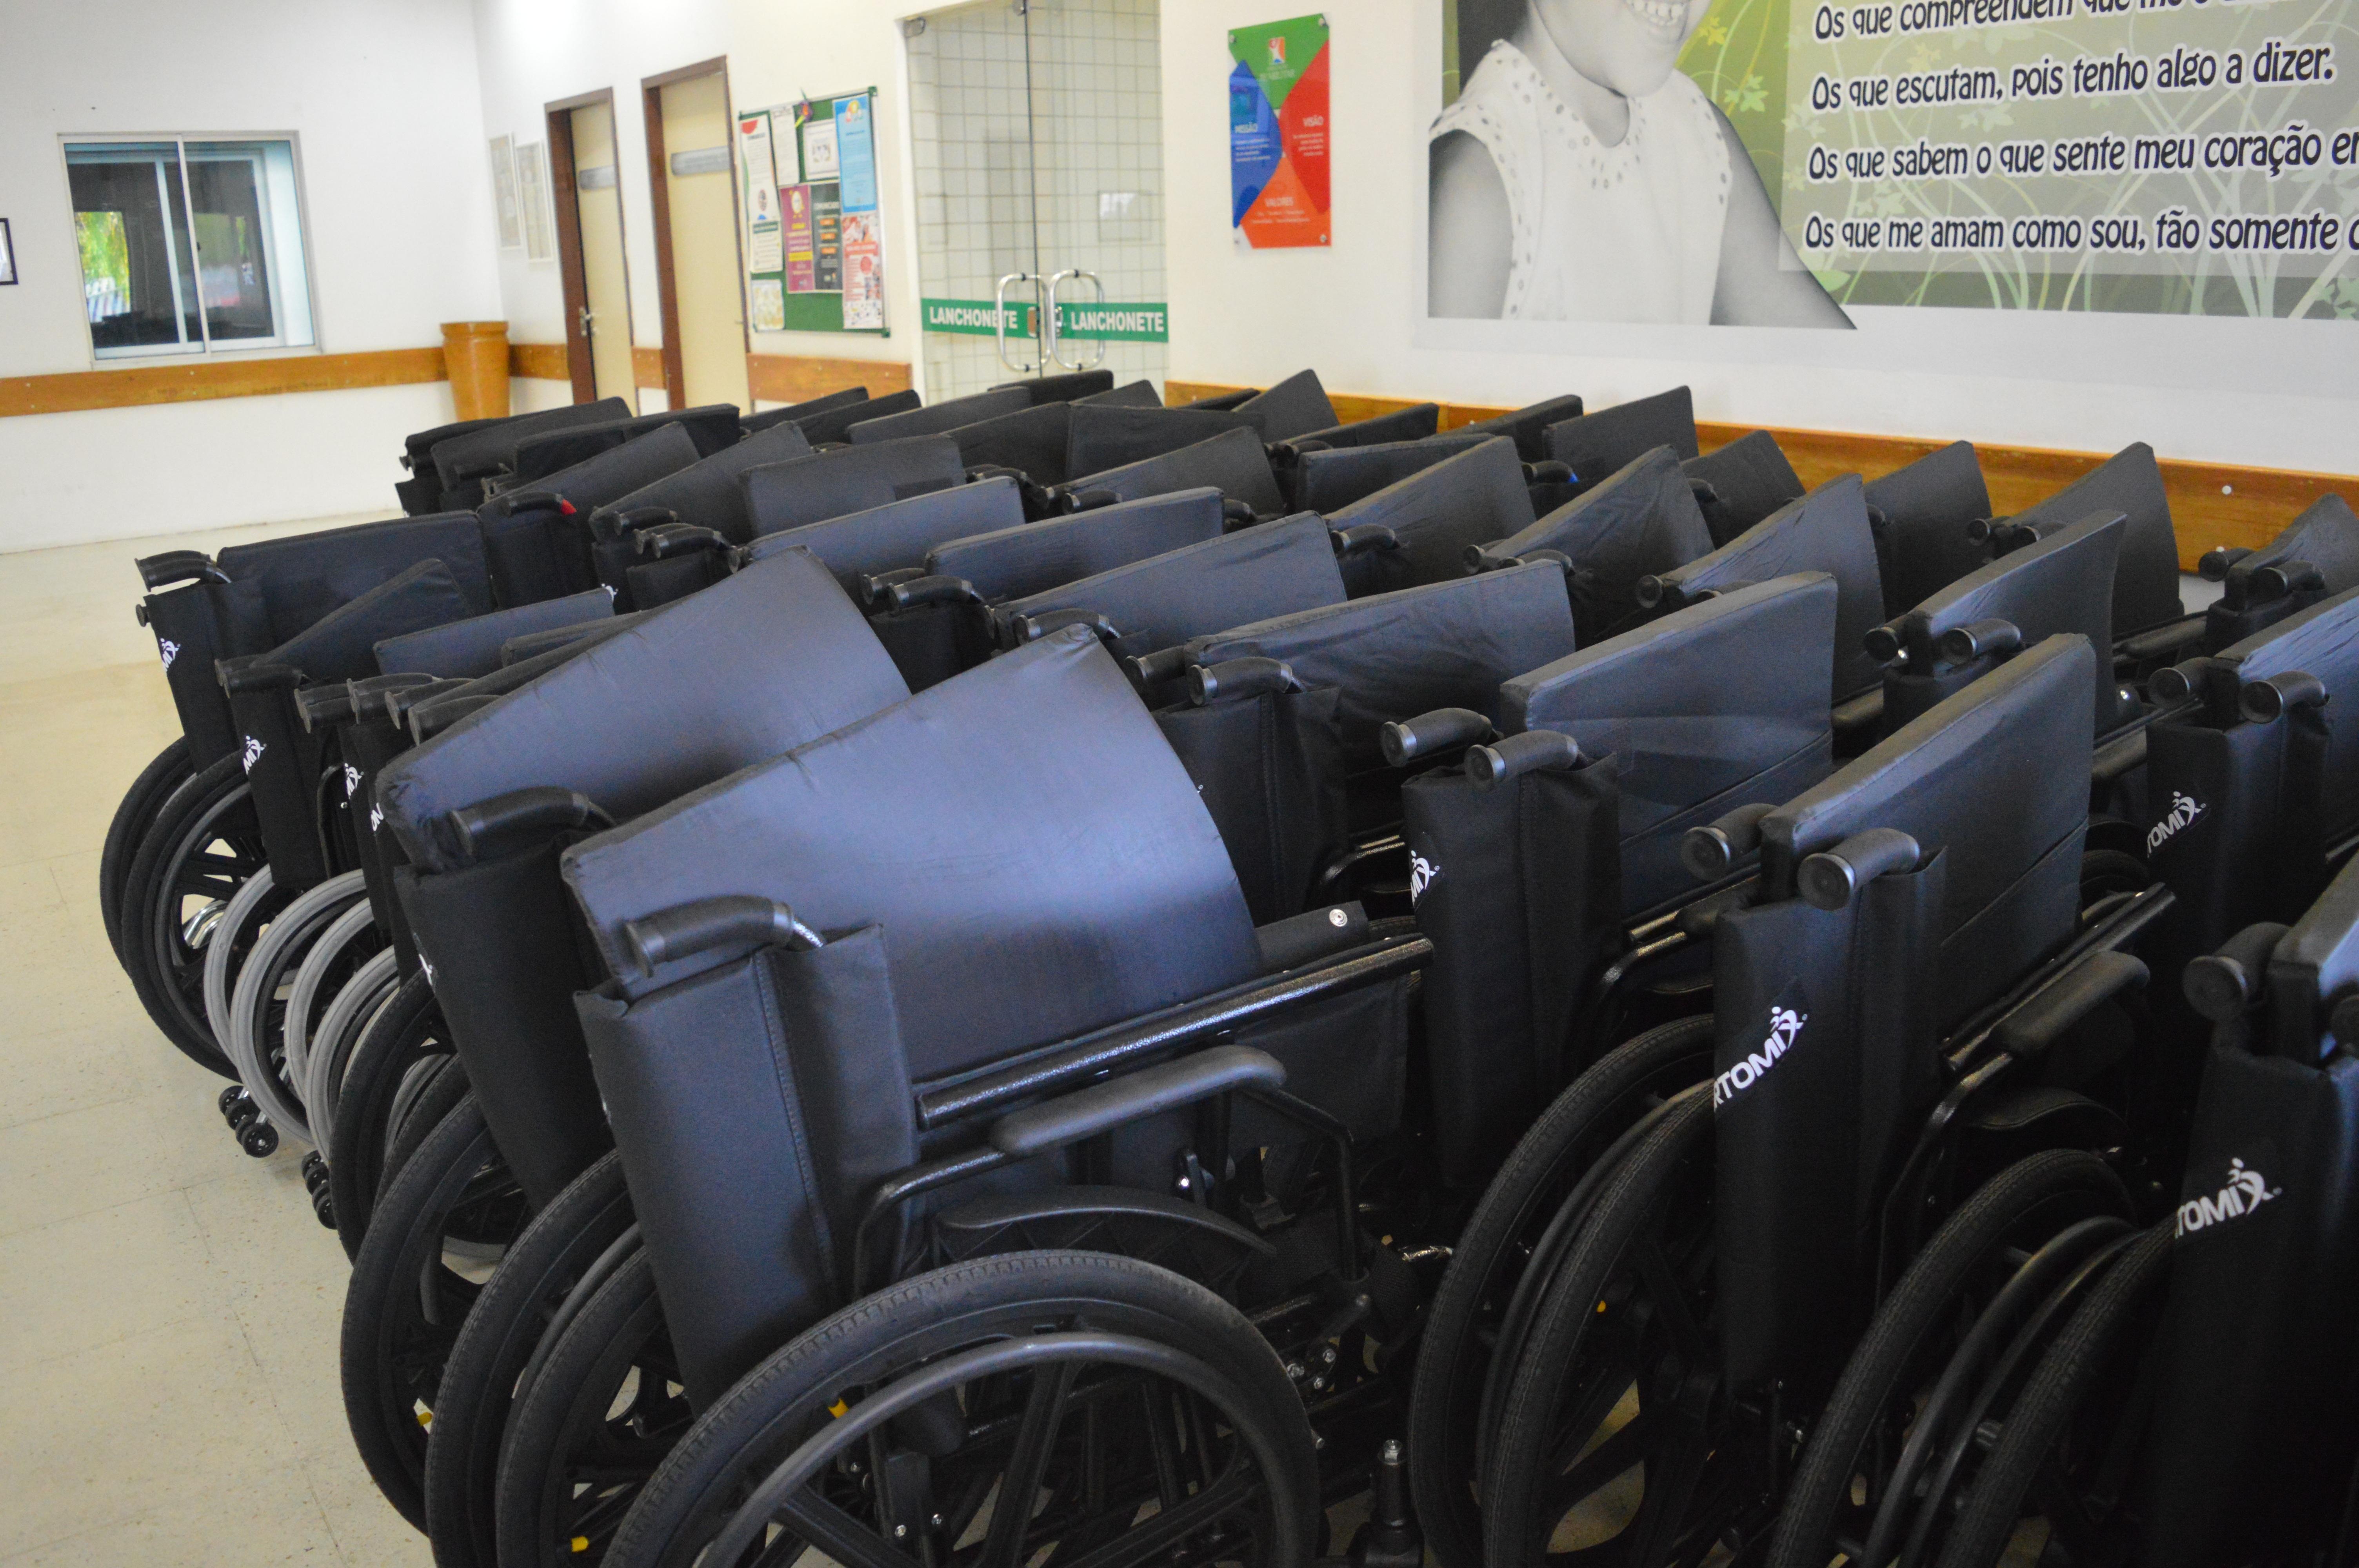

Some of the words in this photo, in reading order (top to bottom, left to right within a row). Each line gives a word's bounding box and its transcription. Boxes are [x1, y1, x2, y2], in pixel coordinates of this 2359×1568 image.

[1816, 7, 1843, 38] Os
[1854, 7, 1891, 34] que
[1813, 78, 1840, 109] Os
[1850, 80, 1887, 105] que
[1897, 70, 2002, 103] escutam,
[2013, 59, 2063, 96] pois
[2074, 53, 2147, 92] tenho
[2158, 49, 2215, 87] algo
[2227, 54, 2242, 83] a
[2255, 42, 2332, 82] dizer.
[1810, 147, 1836, 178] Os
[1846, 152, 1883, 176] que
[1893, 142, 1967, 176] sabem
[1977, 147, 1990, 173] o
[2001, 145, 2044, 172] que
[2054, 137, 2125, 171] sente
[2135, 140, 2194, 168] meu
[2205, 125, 2321, 176] coração
[1807, 217, 1833, 247] Os
[1843, 223, 1879, 247] que
[1889, 222, 1922, 247] me
[1932, 221, 2003, 247] amam
[2013, 220, 2081, 247] como
[2091, 220, 2145, 249] sou,
[2157, 211, 2199, 248] tão
[2210, 213, 2338, 249] somente
[929, 306, 1018, 329] LANCHONETE
[1070, 311, 1164, 332] LANCHONETE
